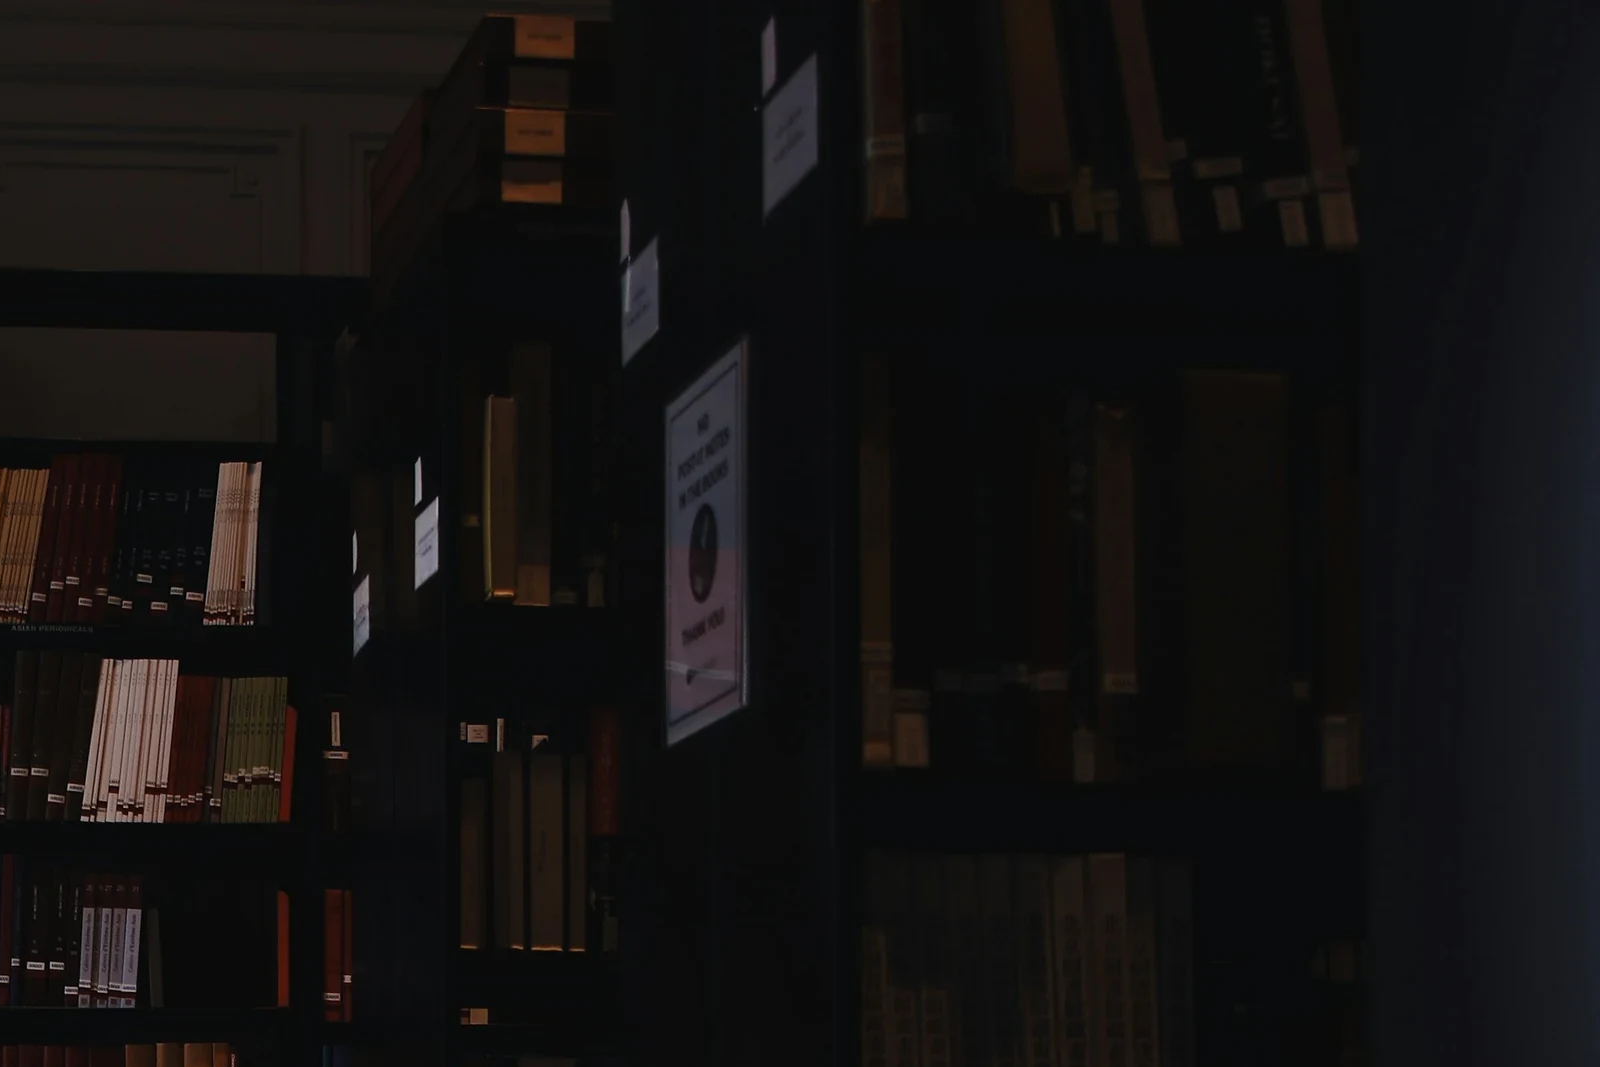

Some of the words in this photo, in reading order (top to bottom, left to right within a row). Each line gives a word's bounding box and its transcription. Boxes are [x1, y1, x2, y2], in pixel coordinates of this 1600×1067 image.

[697, 412, 710, 436] NO
[704, 426, 731, 459] NOTES
[702, 458, 729, 493] BOOKS
